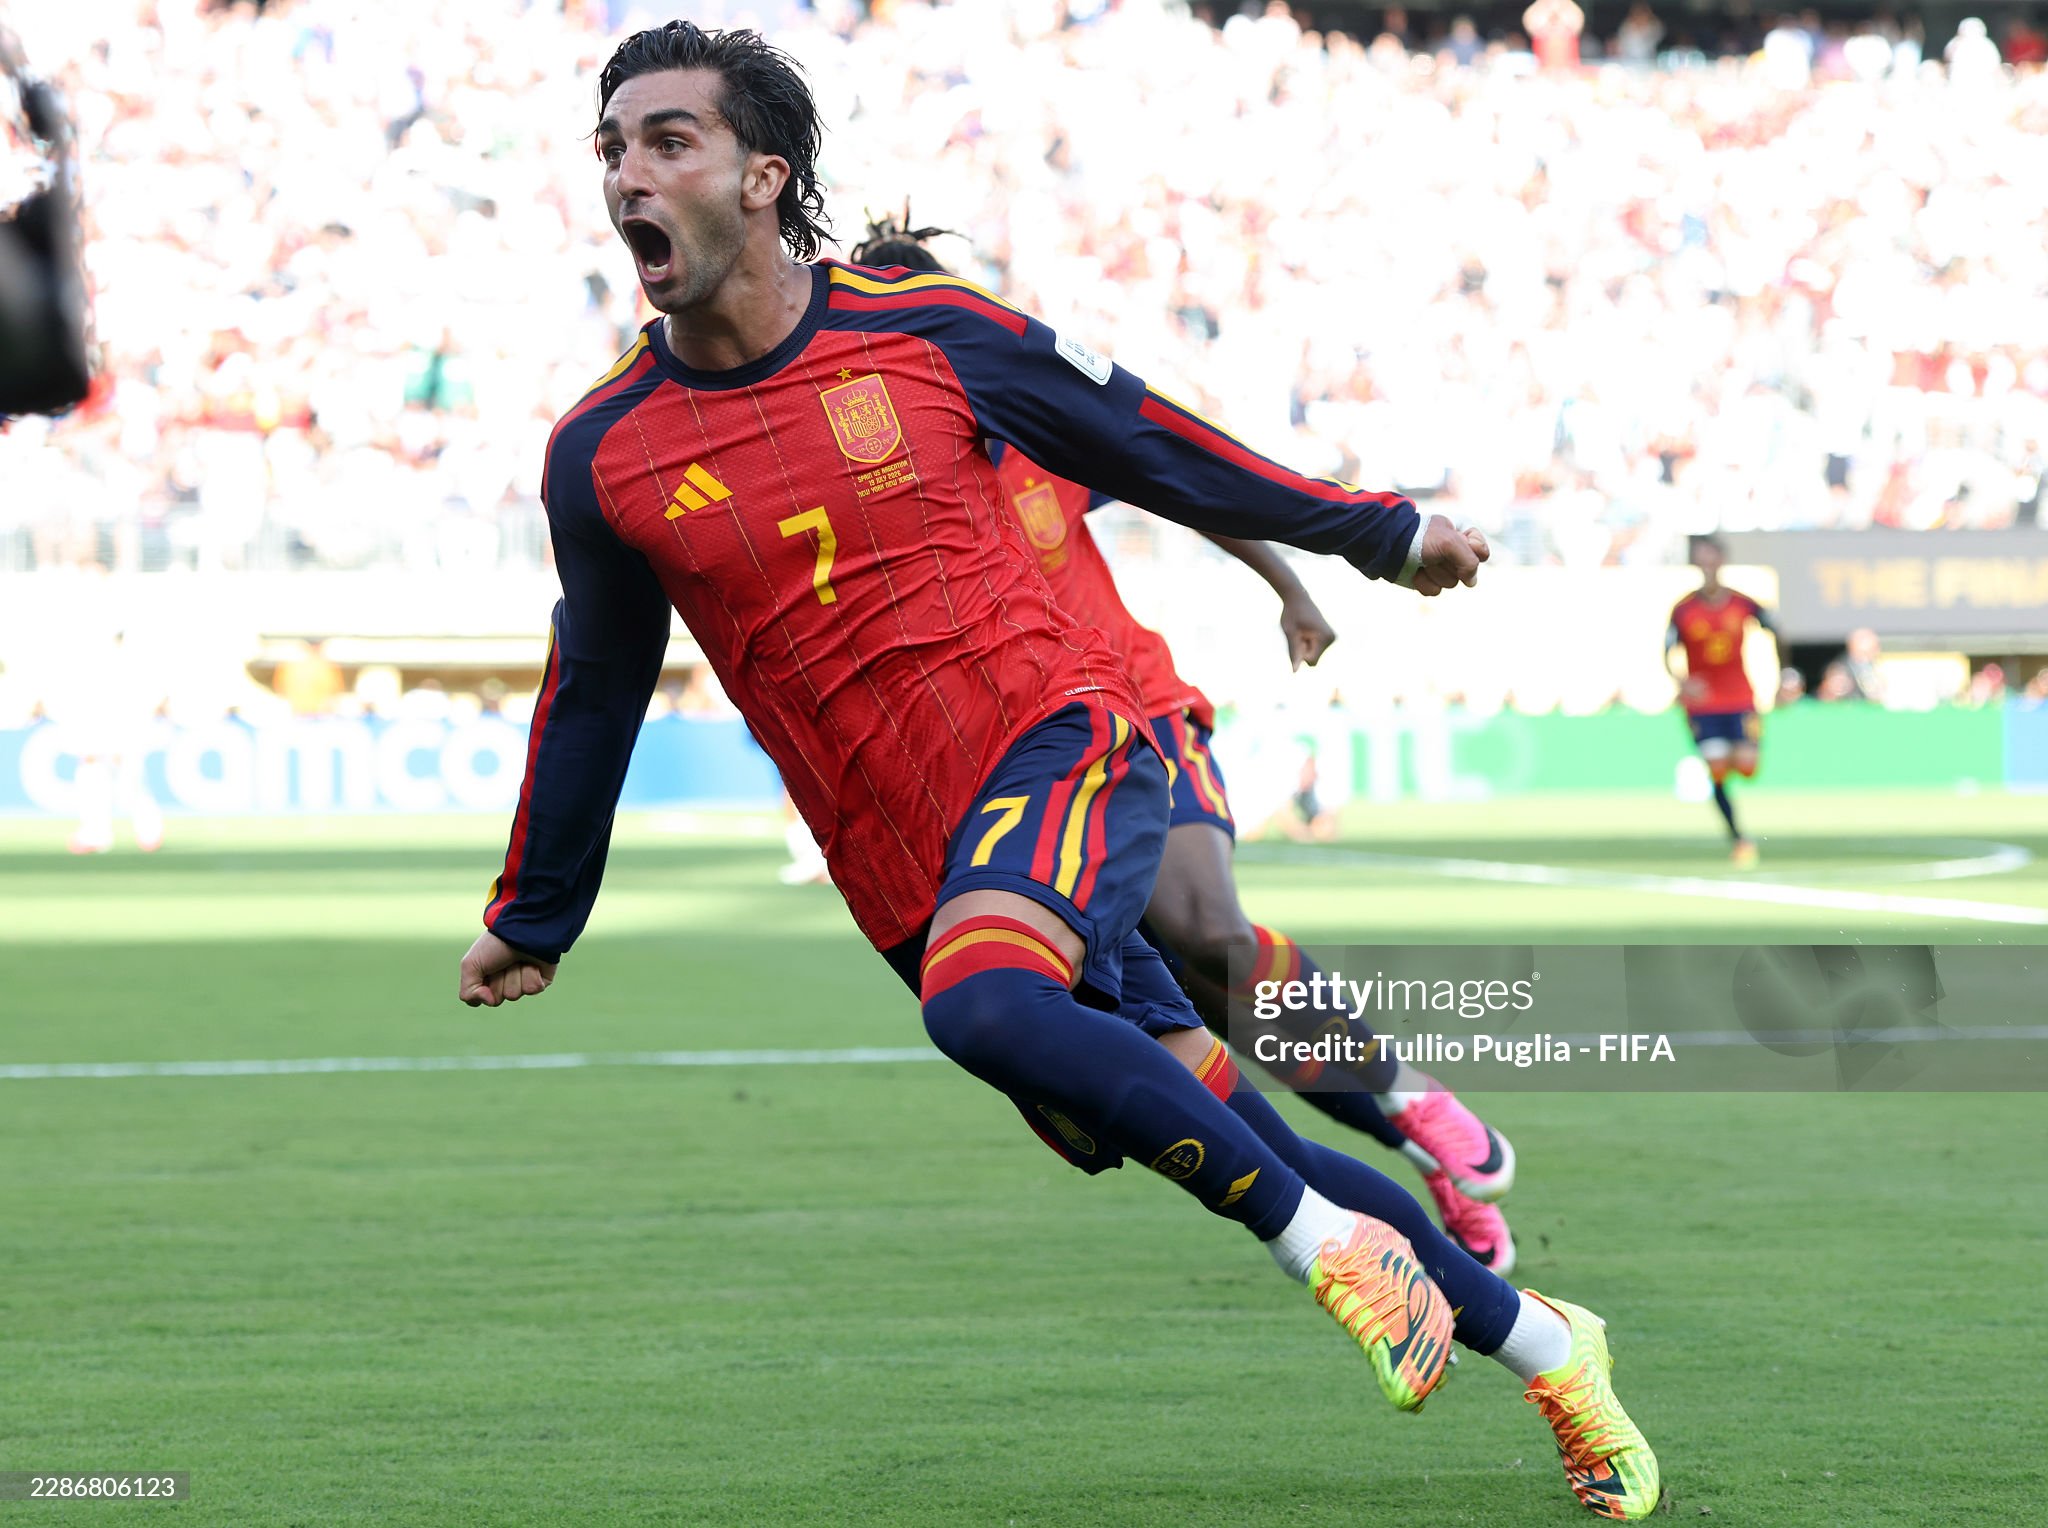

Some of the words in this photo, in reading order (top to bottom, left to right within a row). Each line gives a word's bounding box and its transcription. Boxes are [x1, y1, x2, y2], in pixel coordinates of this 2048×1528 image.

[777, 505, 837, 606] 7
[1812, 557, 1927, 609] THE
[1933, 557, 2048, 609] FIN
[969, 795, 1031, 868] 7
